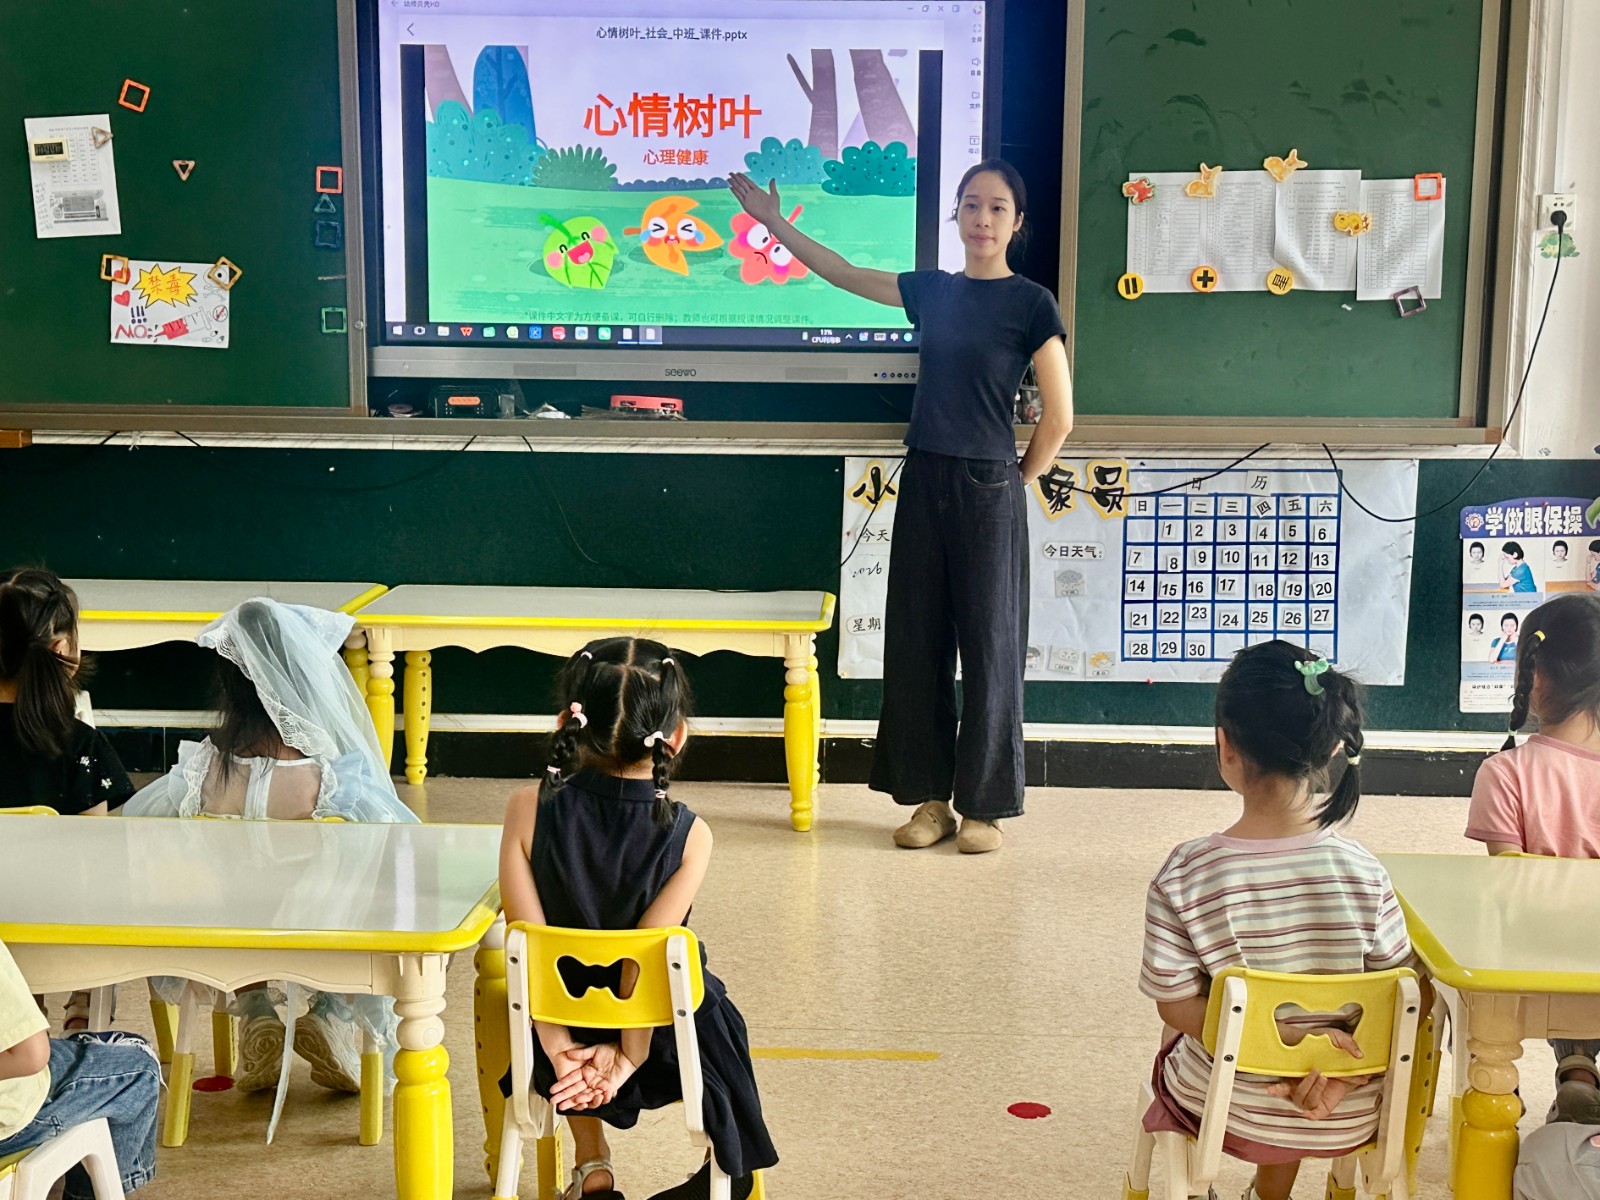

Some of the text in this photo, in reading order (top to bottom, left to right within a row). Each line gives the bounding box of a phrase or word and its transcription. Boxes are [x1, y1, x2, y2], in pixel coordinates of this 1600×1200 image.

[596, 26, 748, 41] 心情树叶_社会_中班_课件.pptx
[583, 92, 762, 139] 心情树叶
[643, 149, 709, 166] 心理健康
[148, 273, 181, 295] 禁毒
[853, 467, 896, 504] 小
[1250, 475, 1268, 489] 历
[1138, 501, 1147, 511] 日
[1194, 503, 1207, 513] 二
[1225, 501, 1238, 513] 三
[1256, 501, 1272, 515] 四
[1288, 499, 1302, 511] 五
[1319, 501, 1333, 513] 六
[1485, 506, 1582, 536] 学做眼保操
[861, 528, 890, 542] 今天
[1165, 523, 1326, 540] 1 2 3 4 5 6
[1133, 551, 1329, 570] 7 8 9 10 11 12 13
[1130, 579, 1332, 596] 14 15 16 17 18 19 20
[853, 616, 881, 632] 星期
[1132, 606, 1330, 626] 21 22 23 24 25 26 27
[1132, 641, 1205, 656] 28 29 30
